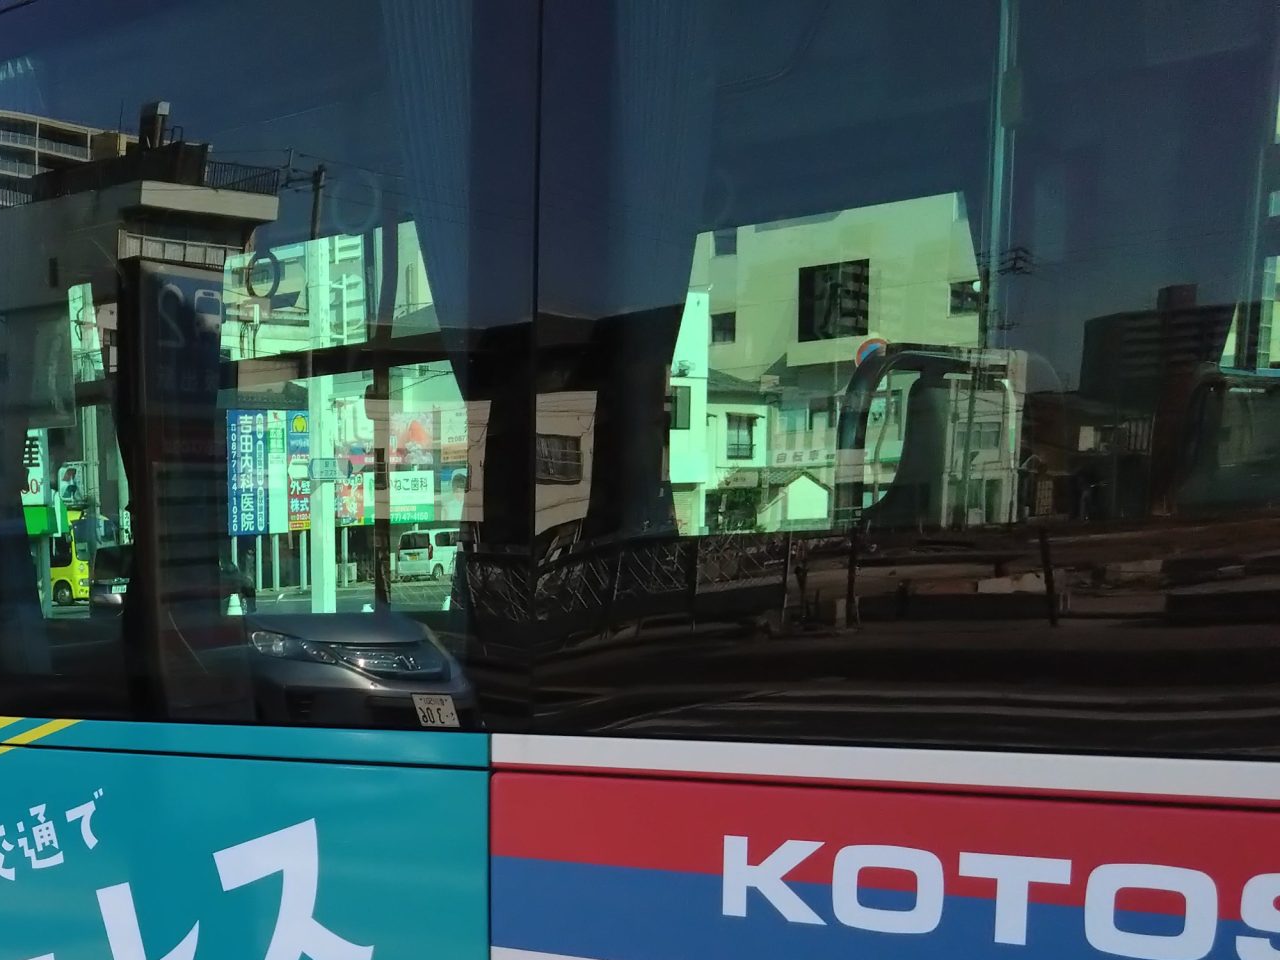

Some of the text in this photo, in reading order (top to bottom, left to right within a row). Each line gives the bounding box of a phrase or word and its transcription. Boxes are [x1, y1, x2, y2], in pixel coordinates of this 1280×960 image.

[240, 414, 254, 531] 吉田内科医院
[391, 477, 427, 491] ねこ歯科
